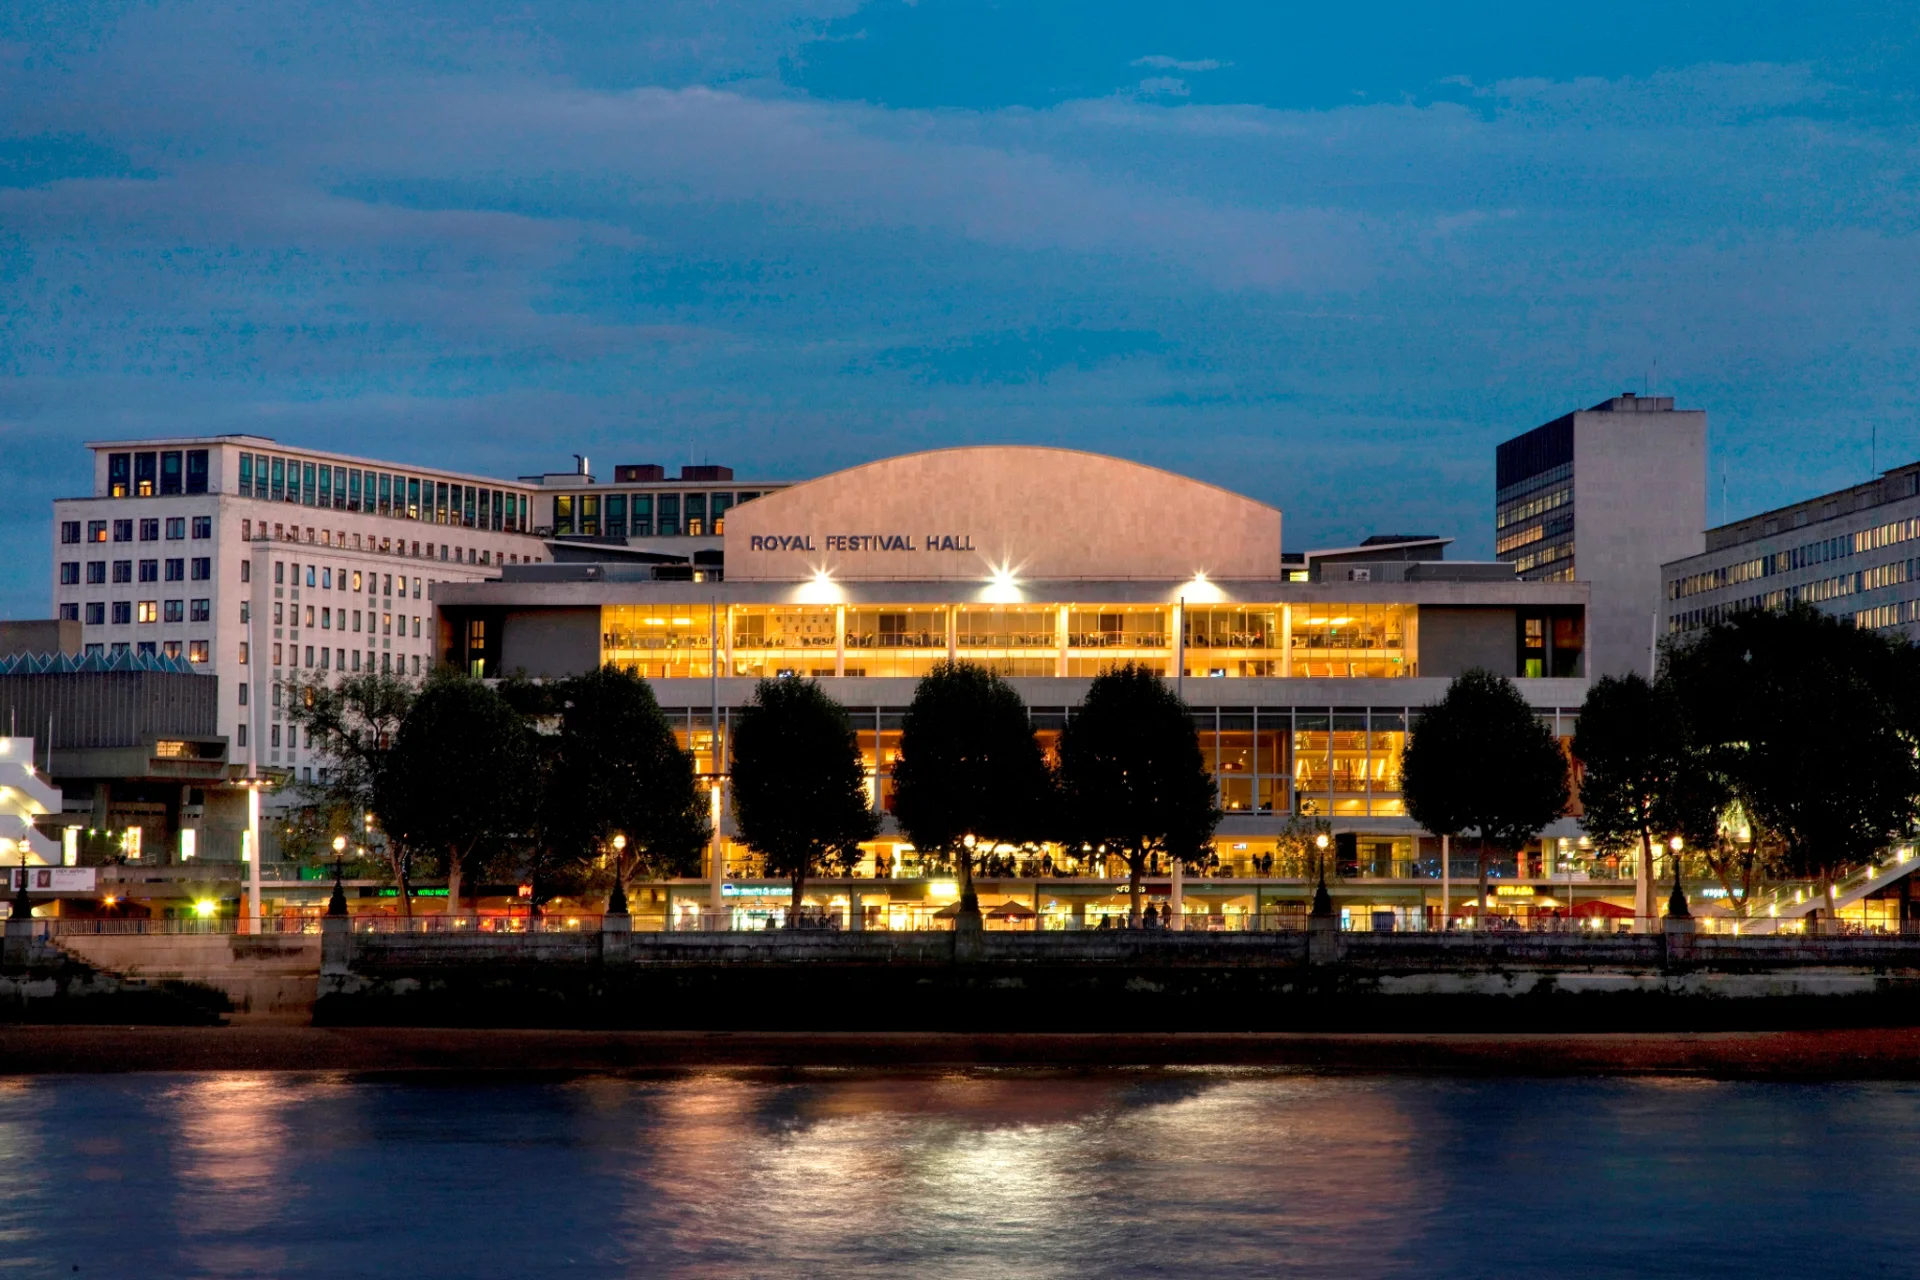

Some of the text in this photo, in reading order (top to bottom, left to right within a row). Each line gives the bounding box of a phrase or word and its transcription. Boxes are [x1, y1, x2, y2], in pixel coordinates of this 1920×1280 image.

[751, 535, 977, 551] ROYAL FESTIVAL HALL
[1497, 885, 1535, 896] STRADA
